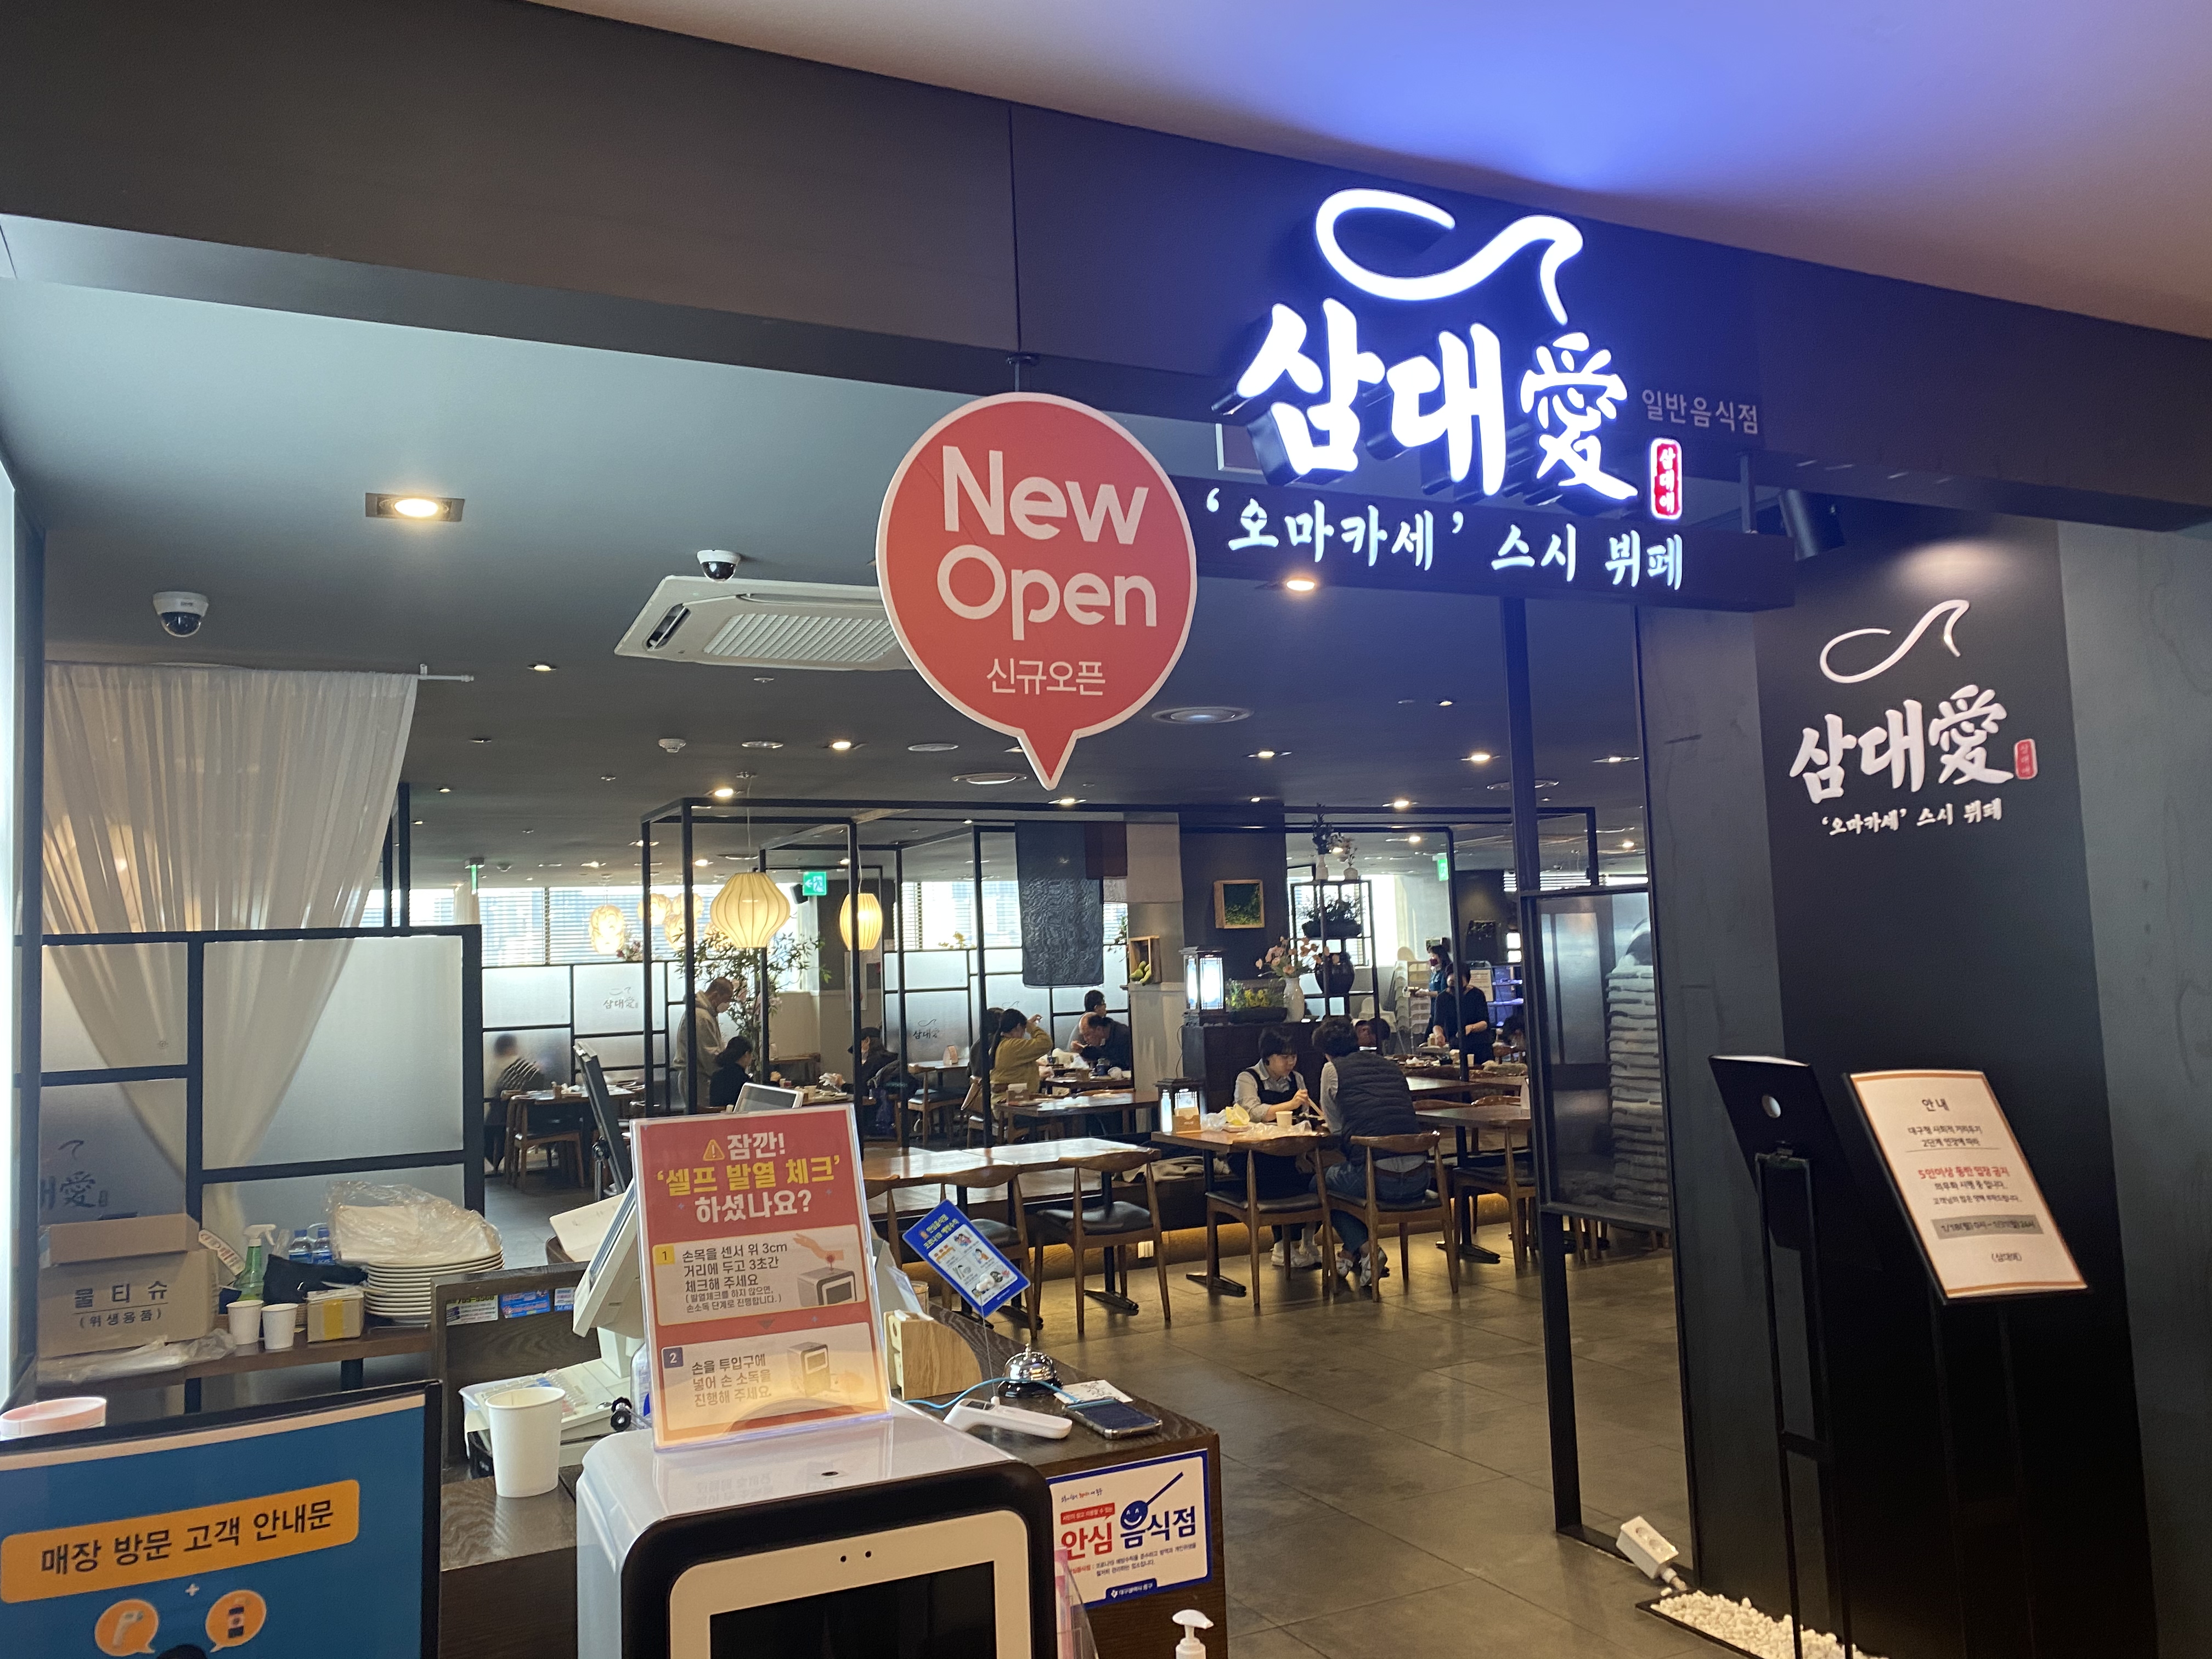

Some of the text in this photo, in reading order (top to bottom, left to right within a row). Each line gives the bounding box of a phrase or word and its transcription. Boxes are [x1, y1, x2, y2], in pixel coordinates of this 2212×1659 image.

[1642, 390, 1758, 435] 일반음식점
[943, 445, 1149, 545] New
[1492, 523, 1577, 581] 스시
[1605, 531, 1683, 590] 뷔페
[937, 544, 1157, 641] Open
[987, 658, 1106, 696] 신규오픈
[1917, 803, 1953, 826] 스시
[1964, 797, 2002, 823] 뷔페
[727, 1132, 786, 1160] 잠깐!
[726, 1161, 776, 1190] 발열
[695, 1189, 811, 1222] 하셨나요?
[662, 1251, 667, 1260] 1
[682, 1243, 787, 1263] 손목을 센서 위 3cm
[684, 1256, 778, 1277] 거리에 두고 3초간
[685, 1274, 758, 1293] 체크해 주세요
[732, 1289, 746, 1298] 하지
[686, 1302, 709, 1313] 손소독
[712, 1300, 735, 1310] 단계로
[669, 1352, 677, 1363] 2
[692, 1354, 765, 1375] 손을 투입구에
[693, 1369, 771, 1391] 넣어 손 소독을
[695, 1390, 730, 1407] 진행해
[41, 1500, 333, 1576] 매장 방문 고객 안내문
[1062, 1500, 1195, 1560] 안심 음식점
